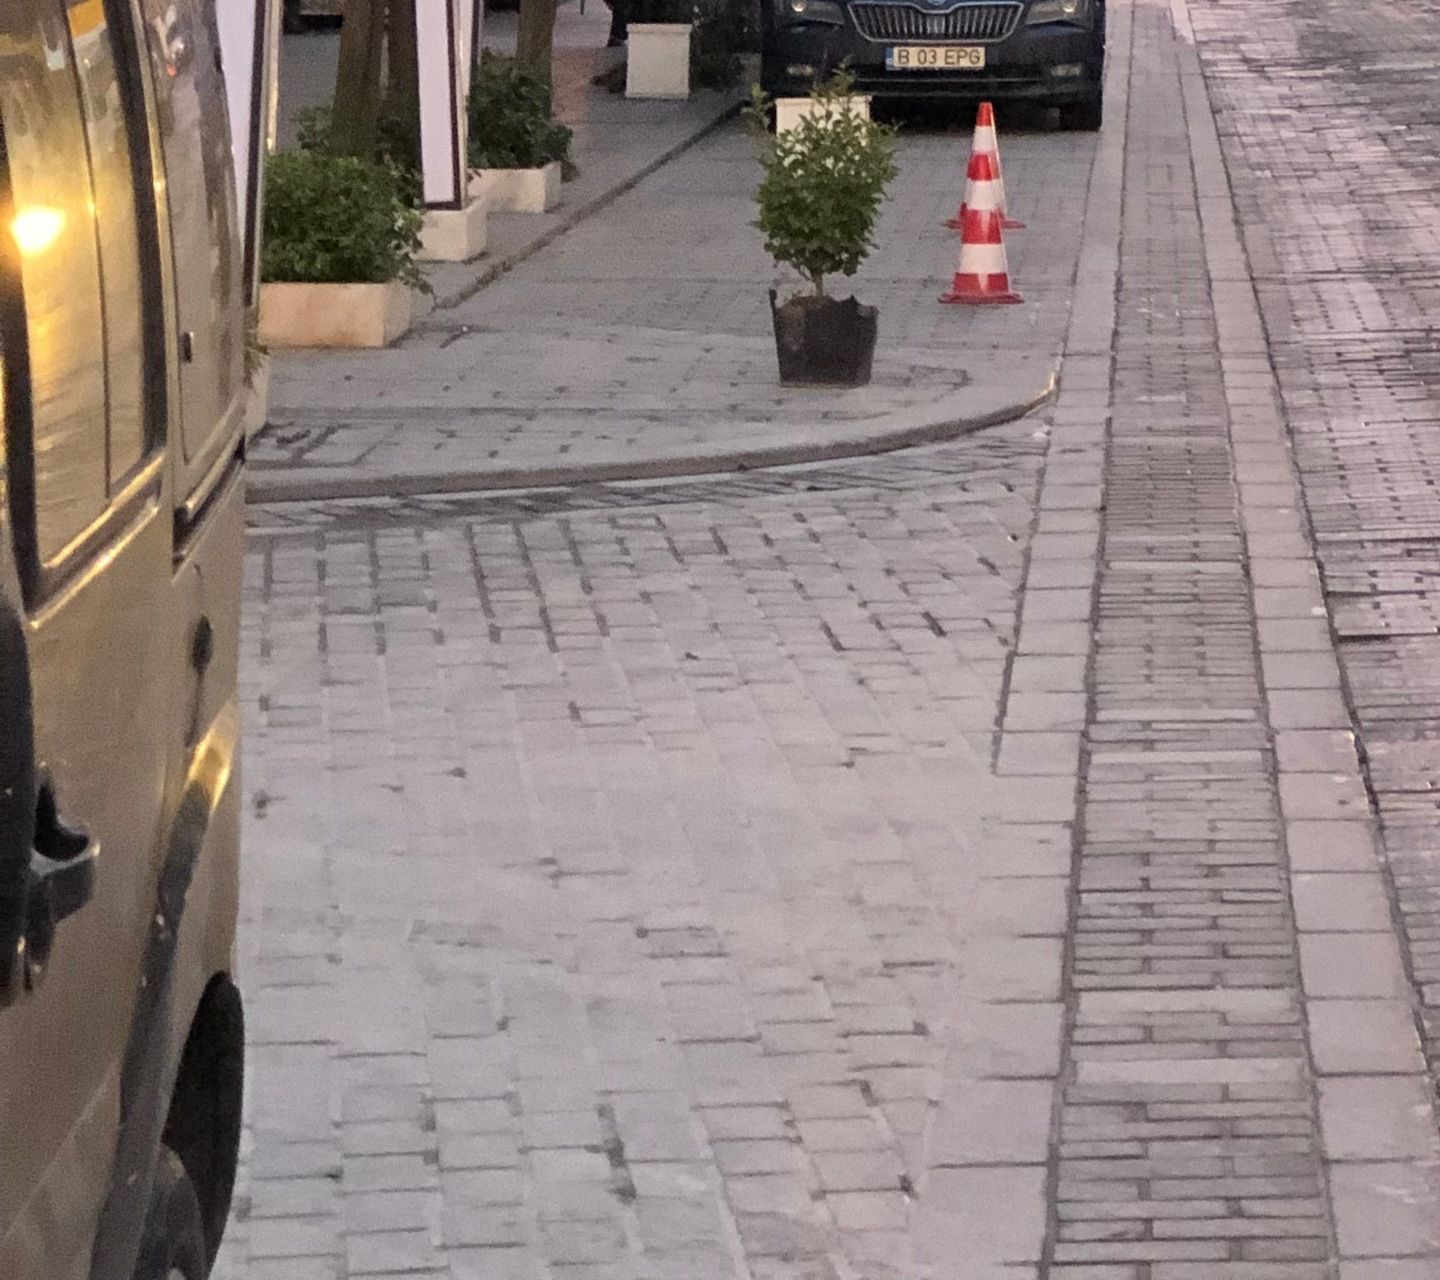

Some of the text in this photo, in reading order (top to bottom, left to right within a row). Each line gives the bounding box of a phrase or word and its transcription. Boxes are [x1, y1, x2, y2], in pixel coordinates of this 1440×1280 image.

[898, 48, 981, 66] B 03 EPG
